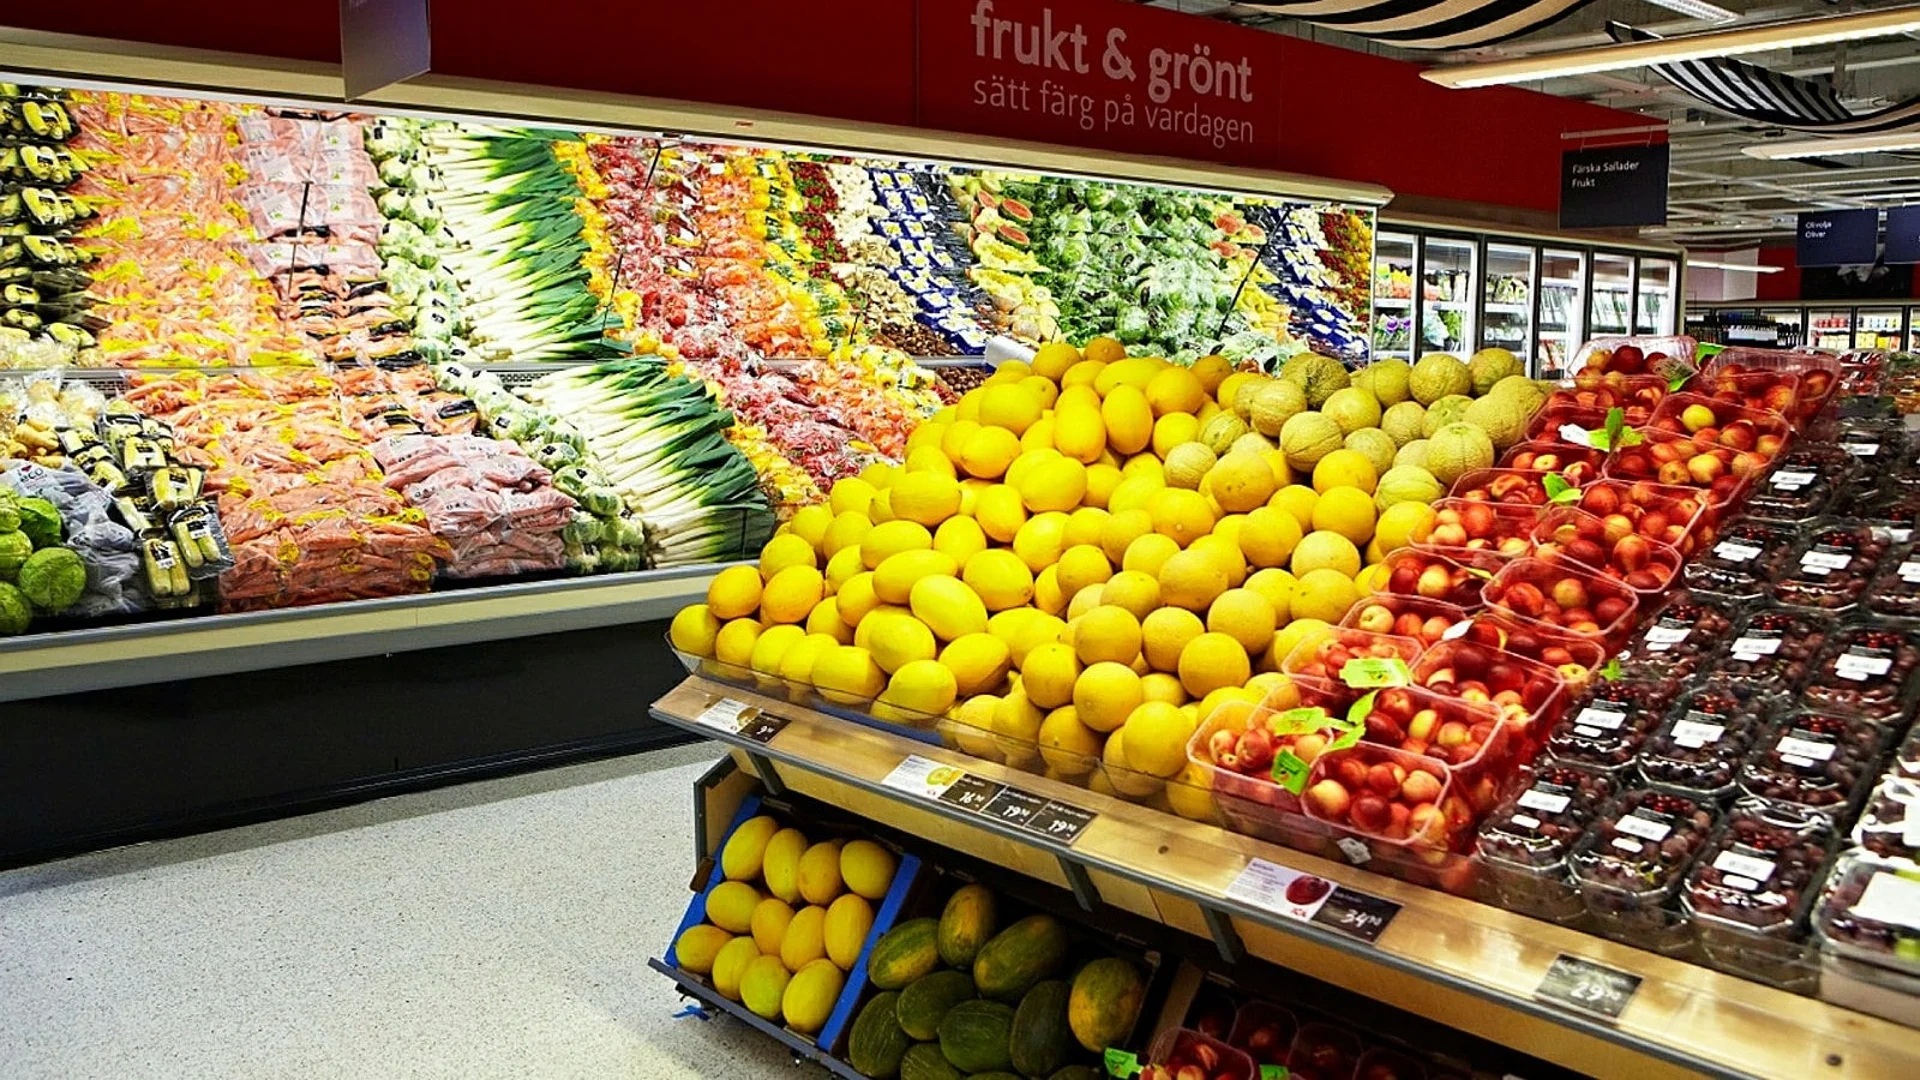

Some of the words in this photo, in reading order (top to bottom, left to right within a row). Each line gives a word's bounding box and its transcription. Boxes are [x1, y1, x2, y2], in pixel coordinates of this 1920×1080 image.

[970, 0, 1089, 74] frukt
[1101, 27, 1137, 82] &
[1148, 43, 1253, 104] grönt
[974, 74, 1030, 111] sätt
[1039, 79, 1095, 131] färg
[1104, 93, 1135, 132] på
[1144, 102, 1253, 149] vardagen
[1571, 178, 1596, 188] Frukt
